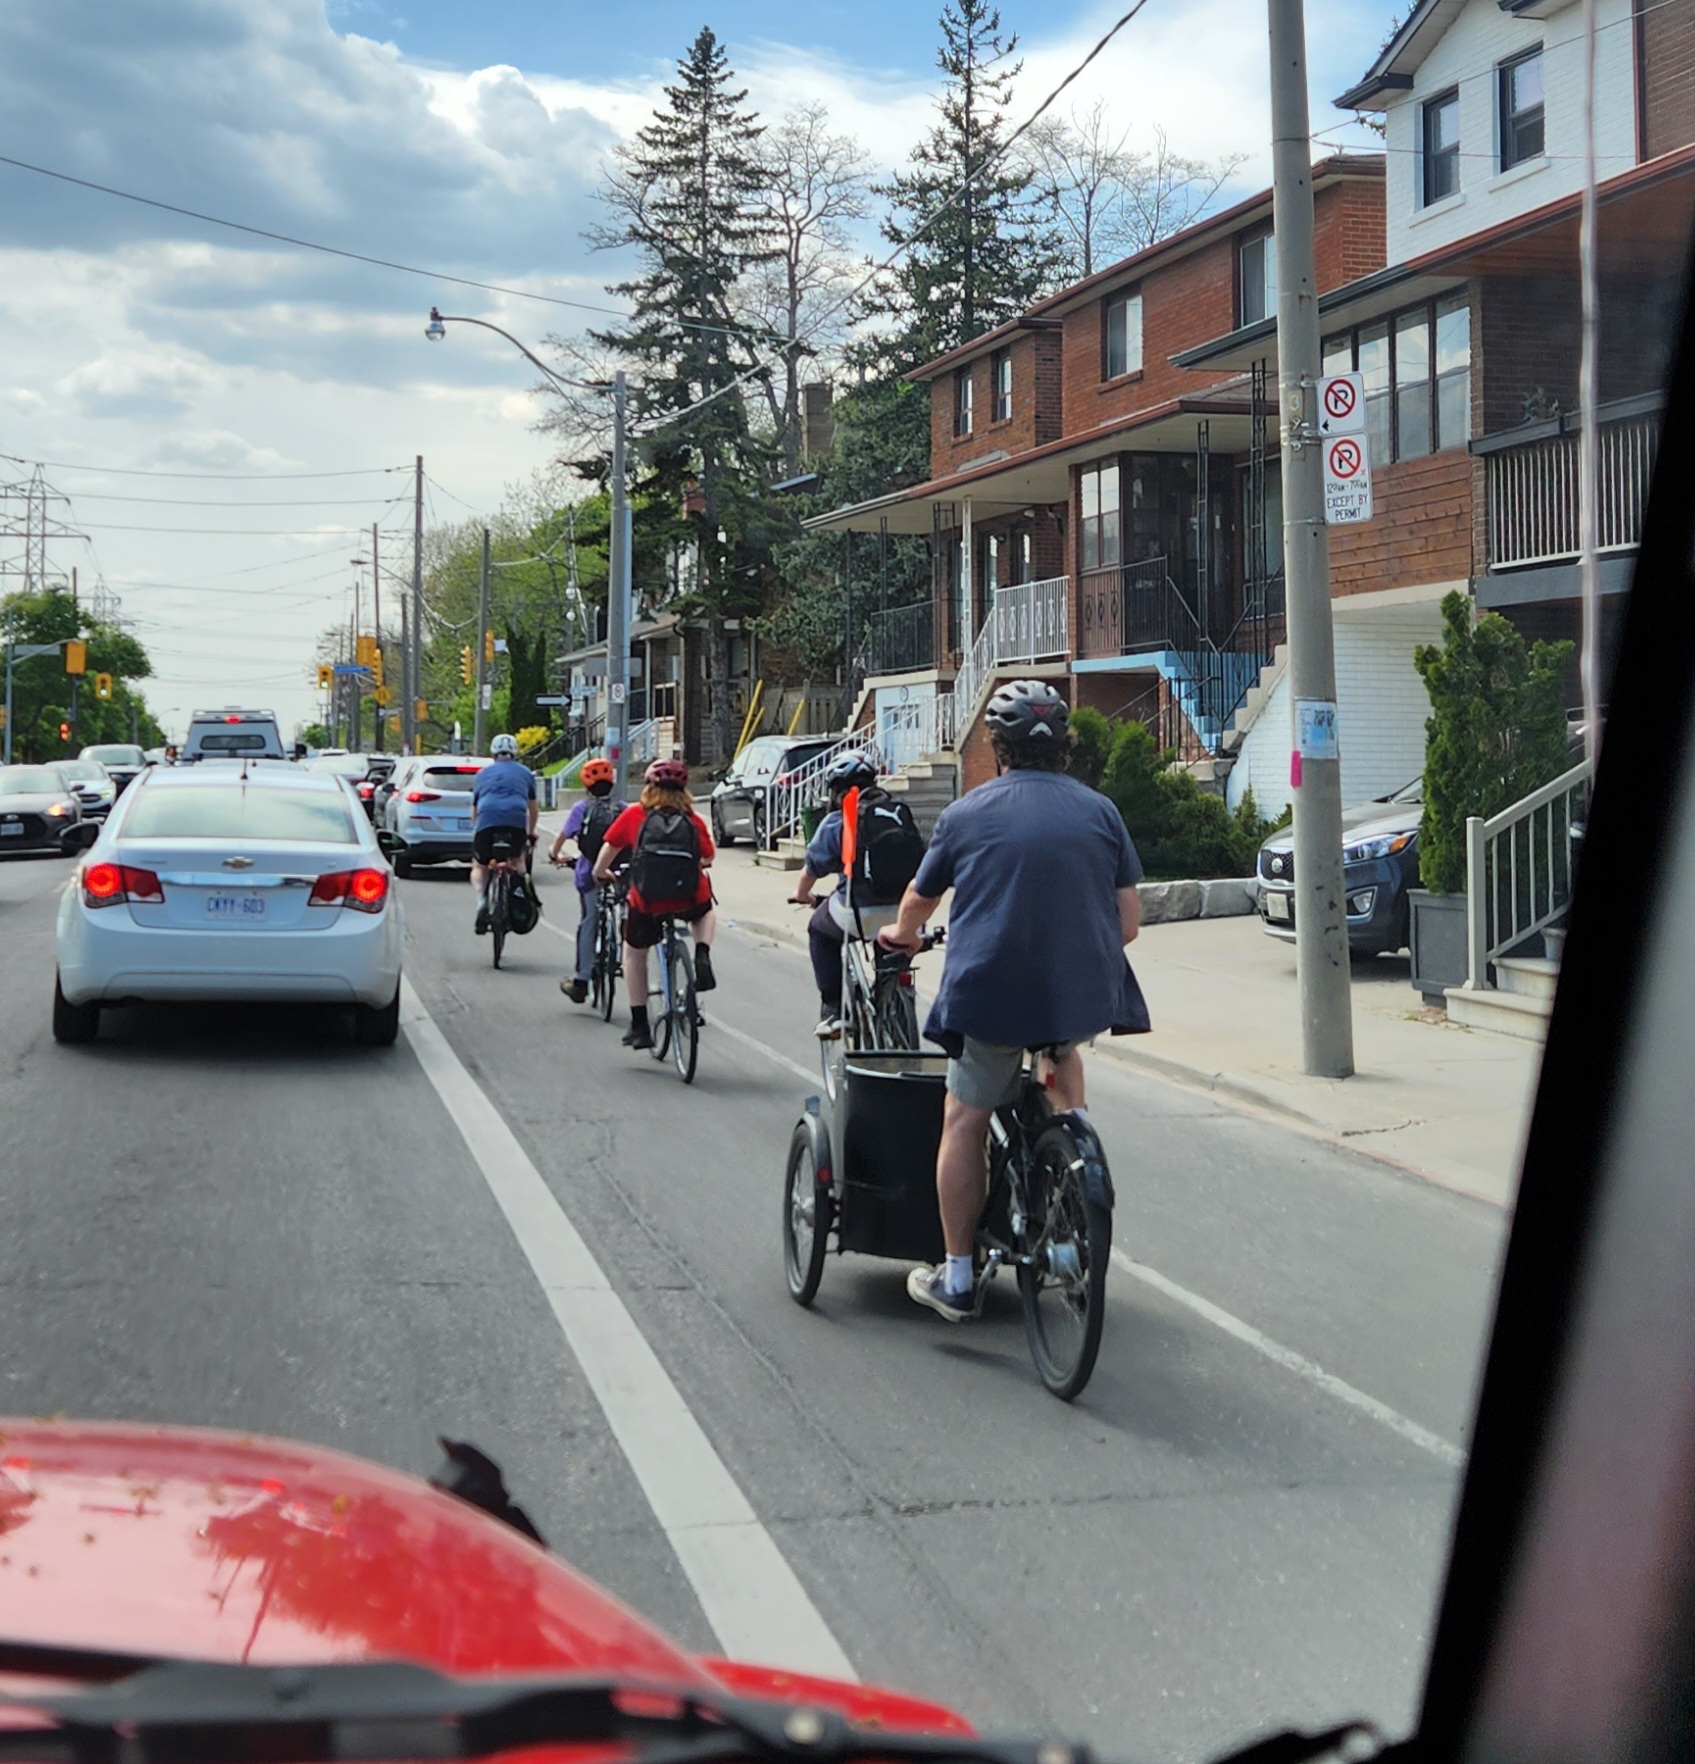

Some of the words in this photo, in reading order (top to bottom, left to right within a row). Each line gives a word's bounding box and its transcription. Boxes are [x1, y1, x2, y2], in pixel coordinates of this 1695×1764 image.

[1326, 494, 1354, 509] EXCEPT
[1358, 493, 1368, 505] BY
[1335, 507, 1361, 521] PERMIT
